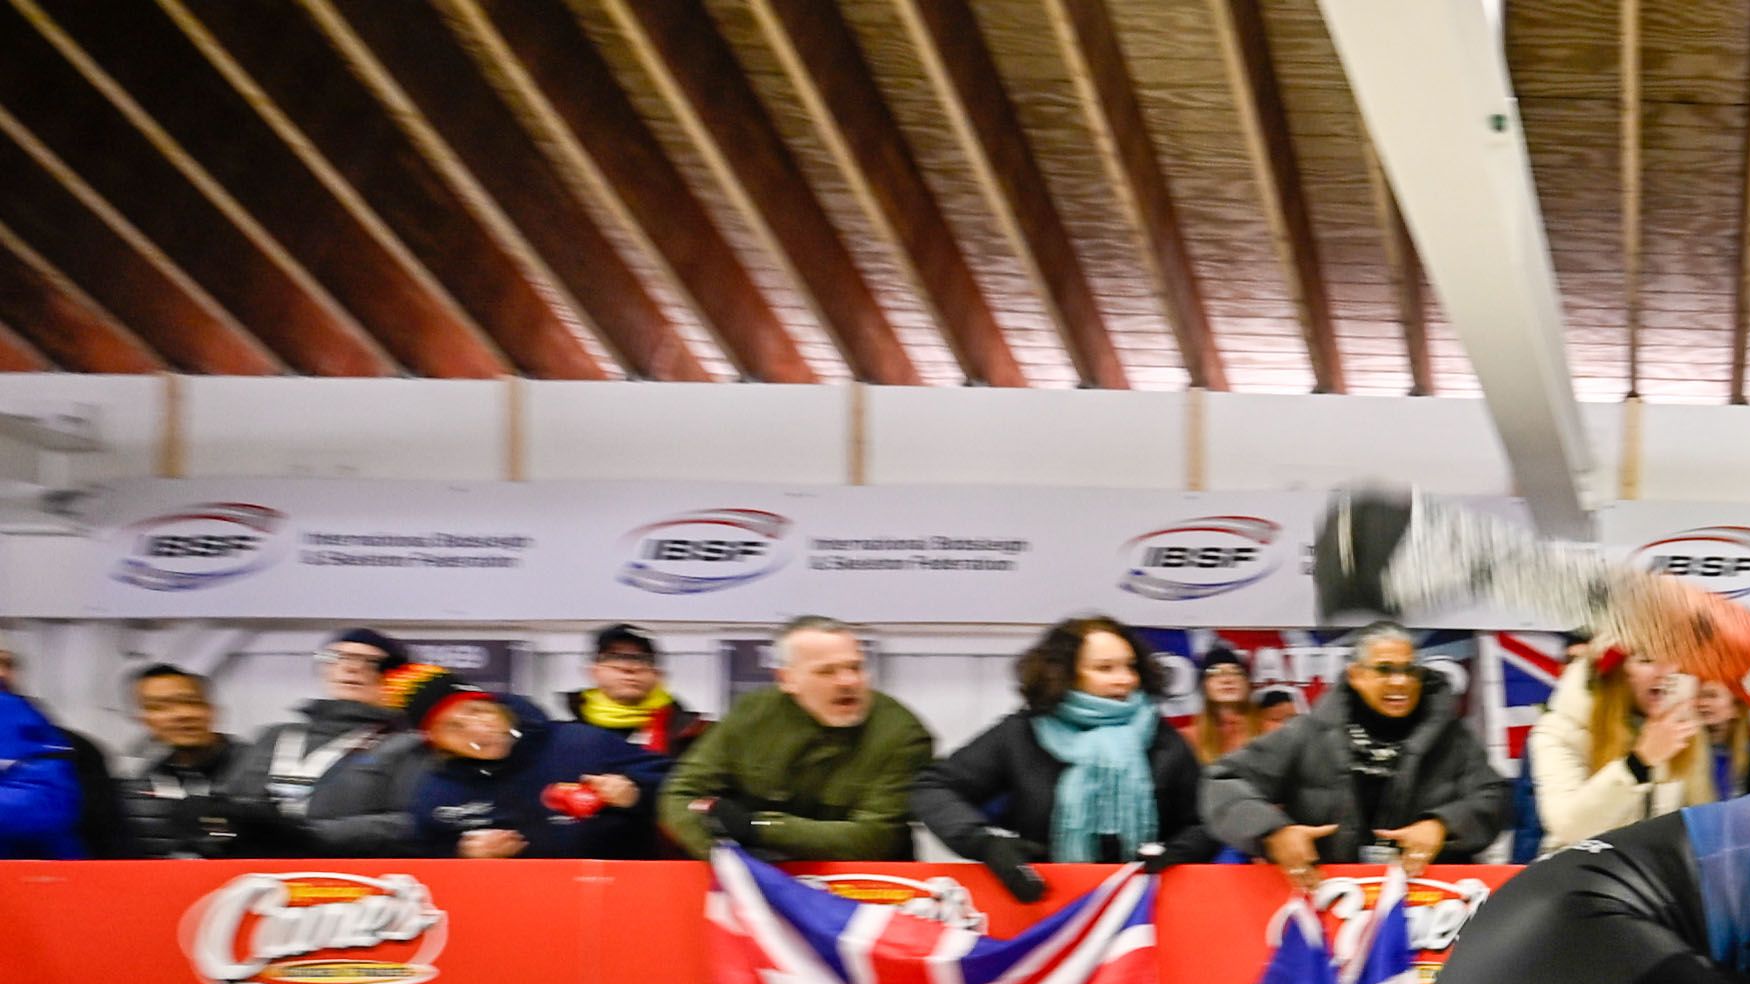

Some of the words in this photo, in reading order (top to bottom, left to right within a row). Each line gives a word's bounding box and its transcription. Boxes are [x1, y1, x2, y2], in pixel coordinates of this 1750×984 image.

[641, 539, 769, 562] IBSF
[1143, 547, 1261, 568] IBSF
[193, 873, 442, 983] Cane's
